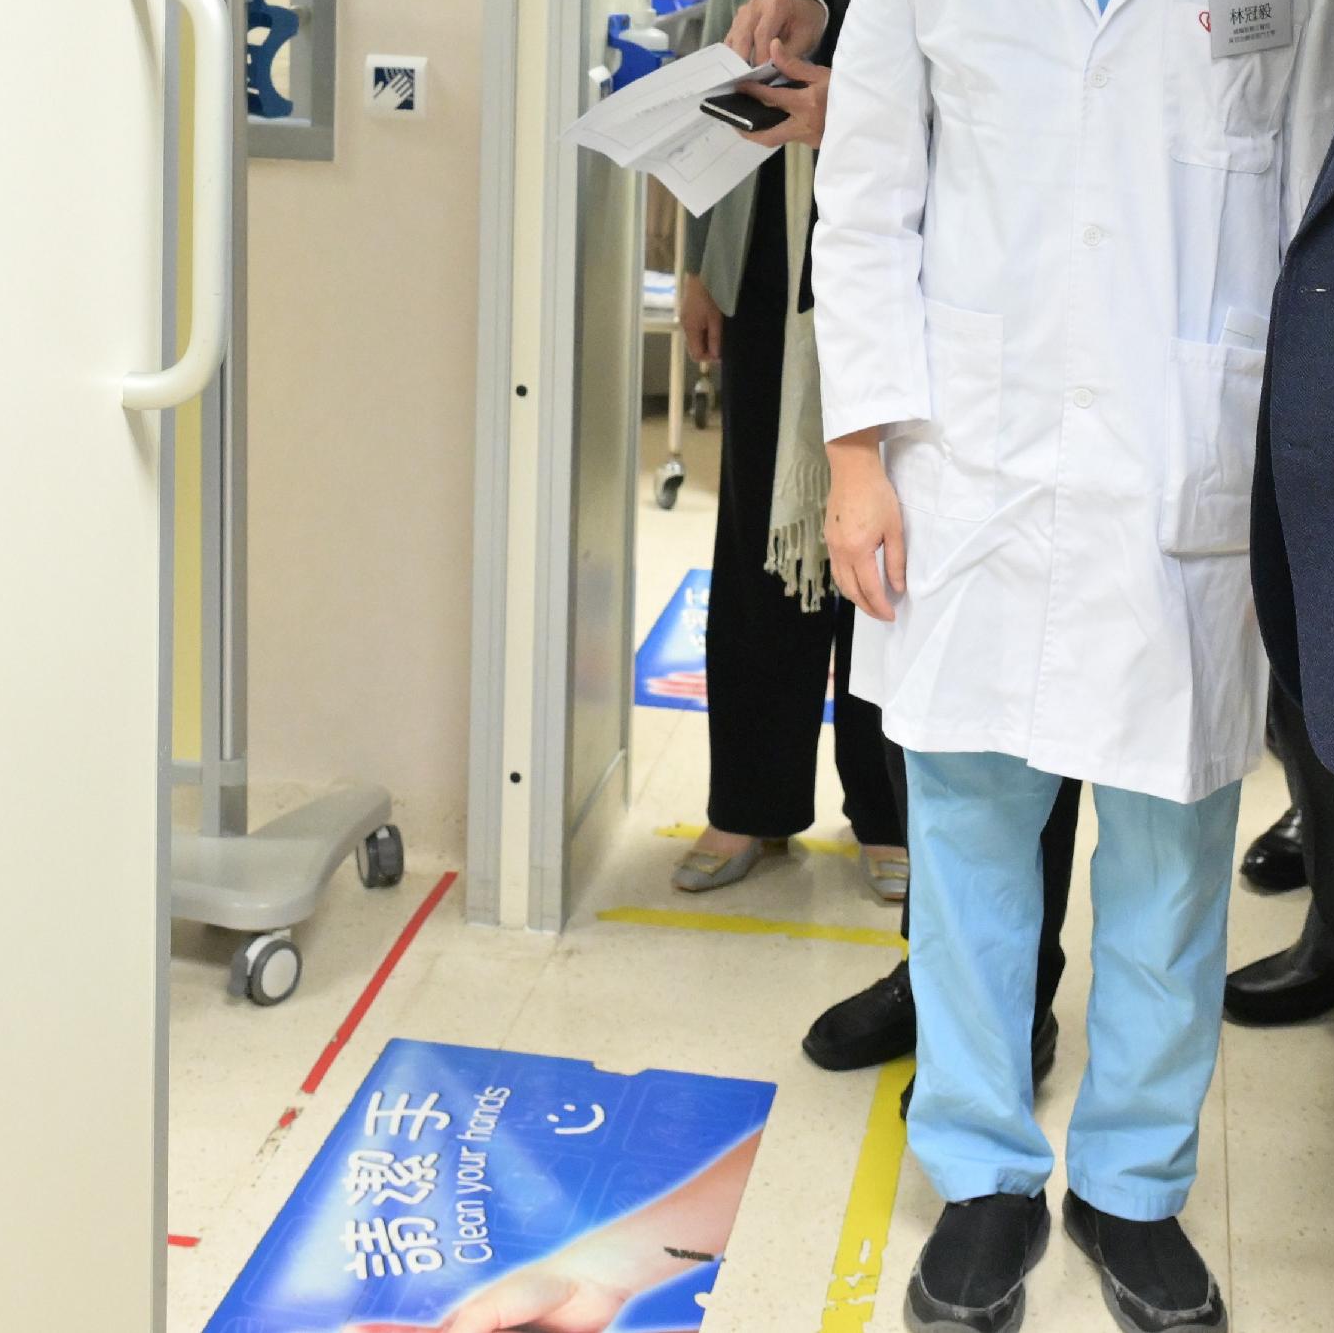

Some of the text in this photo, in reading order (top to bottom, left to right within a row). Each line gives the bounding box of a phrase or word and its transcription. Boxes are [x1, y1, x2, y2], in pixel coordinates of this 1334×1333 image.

[340, 1090, 451, 1280] 請潔手
[452, 1085, 511, 1264] Clean your hands
